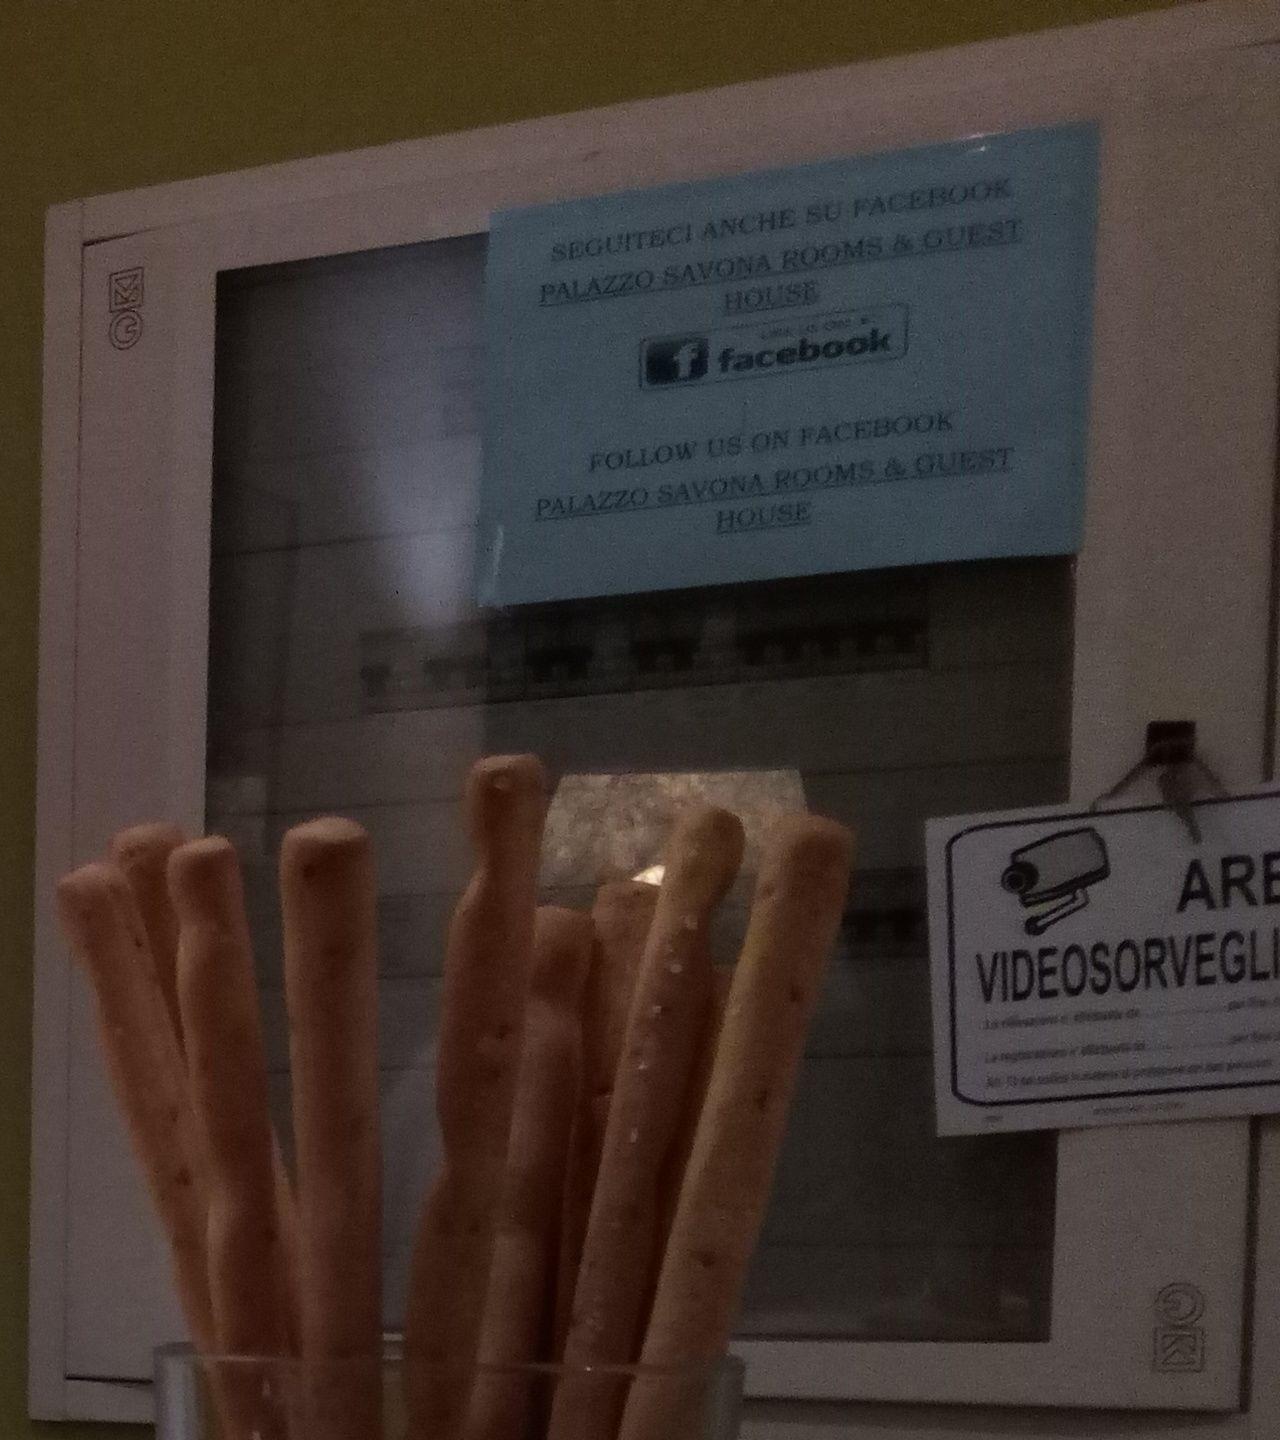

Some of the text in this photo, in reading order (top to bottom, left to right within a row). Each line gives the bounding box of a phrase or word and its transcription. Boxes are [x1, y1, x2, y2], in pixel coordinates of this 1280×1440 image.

[551, 223, 692, 262] SEGUITECI
[703, 208, 794, 240] ANCHE
[853, 178, 1012, 218] FACEBOOK
[540, 269, 654, 304] PALAZZO
[662, 253, 771, 286] SAVONA
[782, 236, 883, 270] ROOMS
[924, 218, 1022, 249] GUEST
[725, 280, 818, 310] HOUSE
[718, 328, 891, 374] facebook
[590, 410, 954, 472] FOLLOW US ON FACEBOOK
[537, 486, 648, 516] PALAZZO
[657, 473, 763, 502] SAVONA
[774, 458, 874, 489] ROOMS
[915, 446, 1014, 476] GUEST
[716, 501, 811, 530] HOUSE
[975, 926, 1280, 1004] VIDEOSORVEGLI
